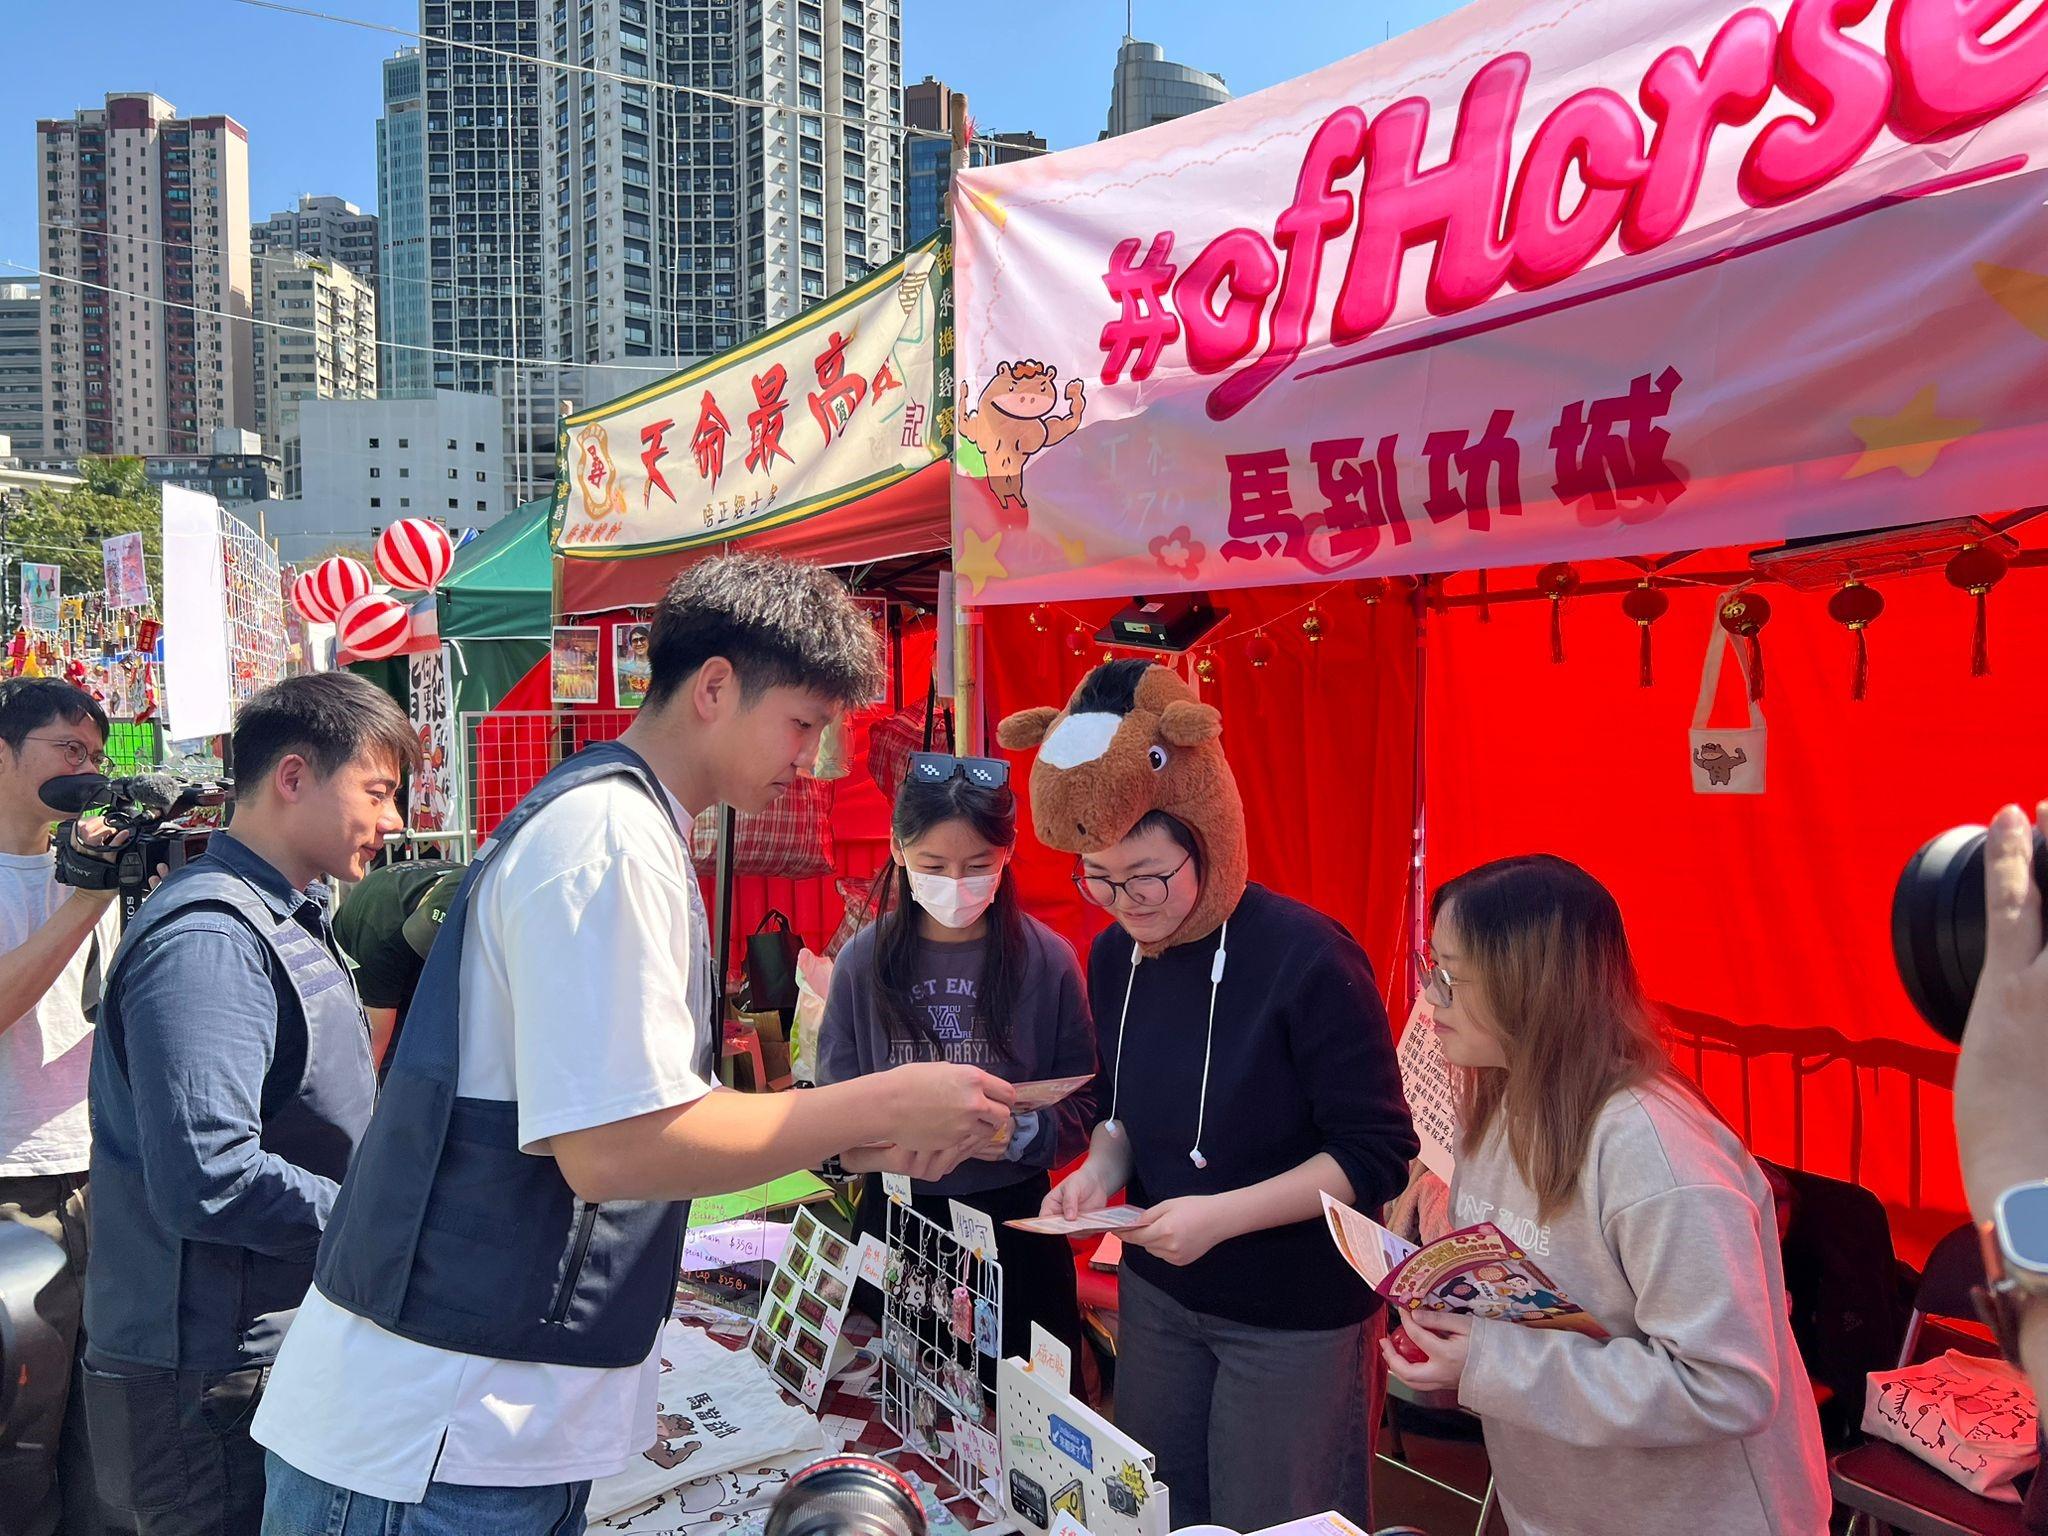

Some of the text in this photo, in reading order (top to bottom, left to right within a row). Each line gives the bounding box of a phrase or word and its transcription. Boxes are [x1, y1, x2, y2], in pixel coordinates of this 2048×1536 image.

[900, 397, 925, 448] 記
[1219, 365, 1688, 563] 馬到功城
[66, 862, 92, 877] SONY
